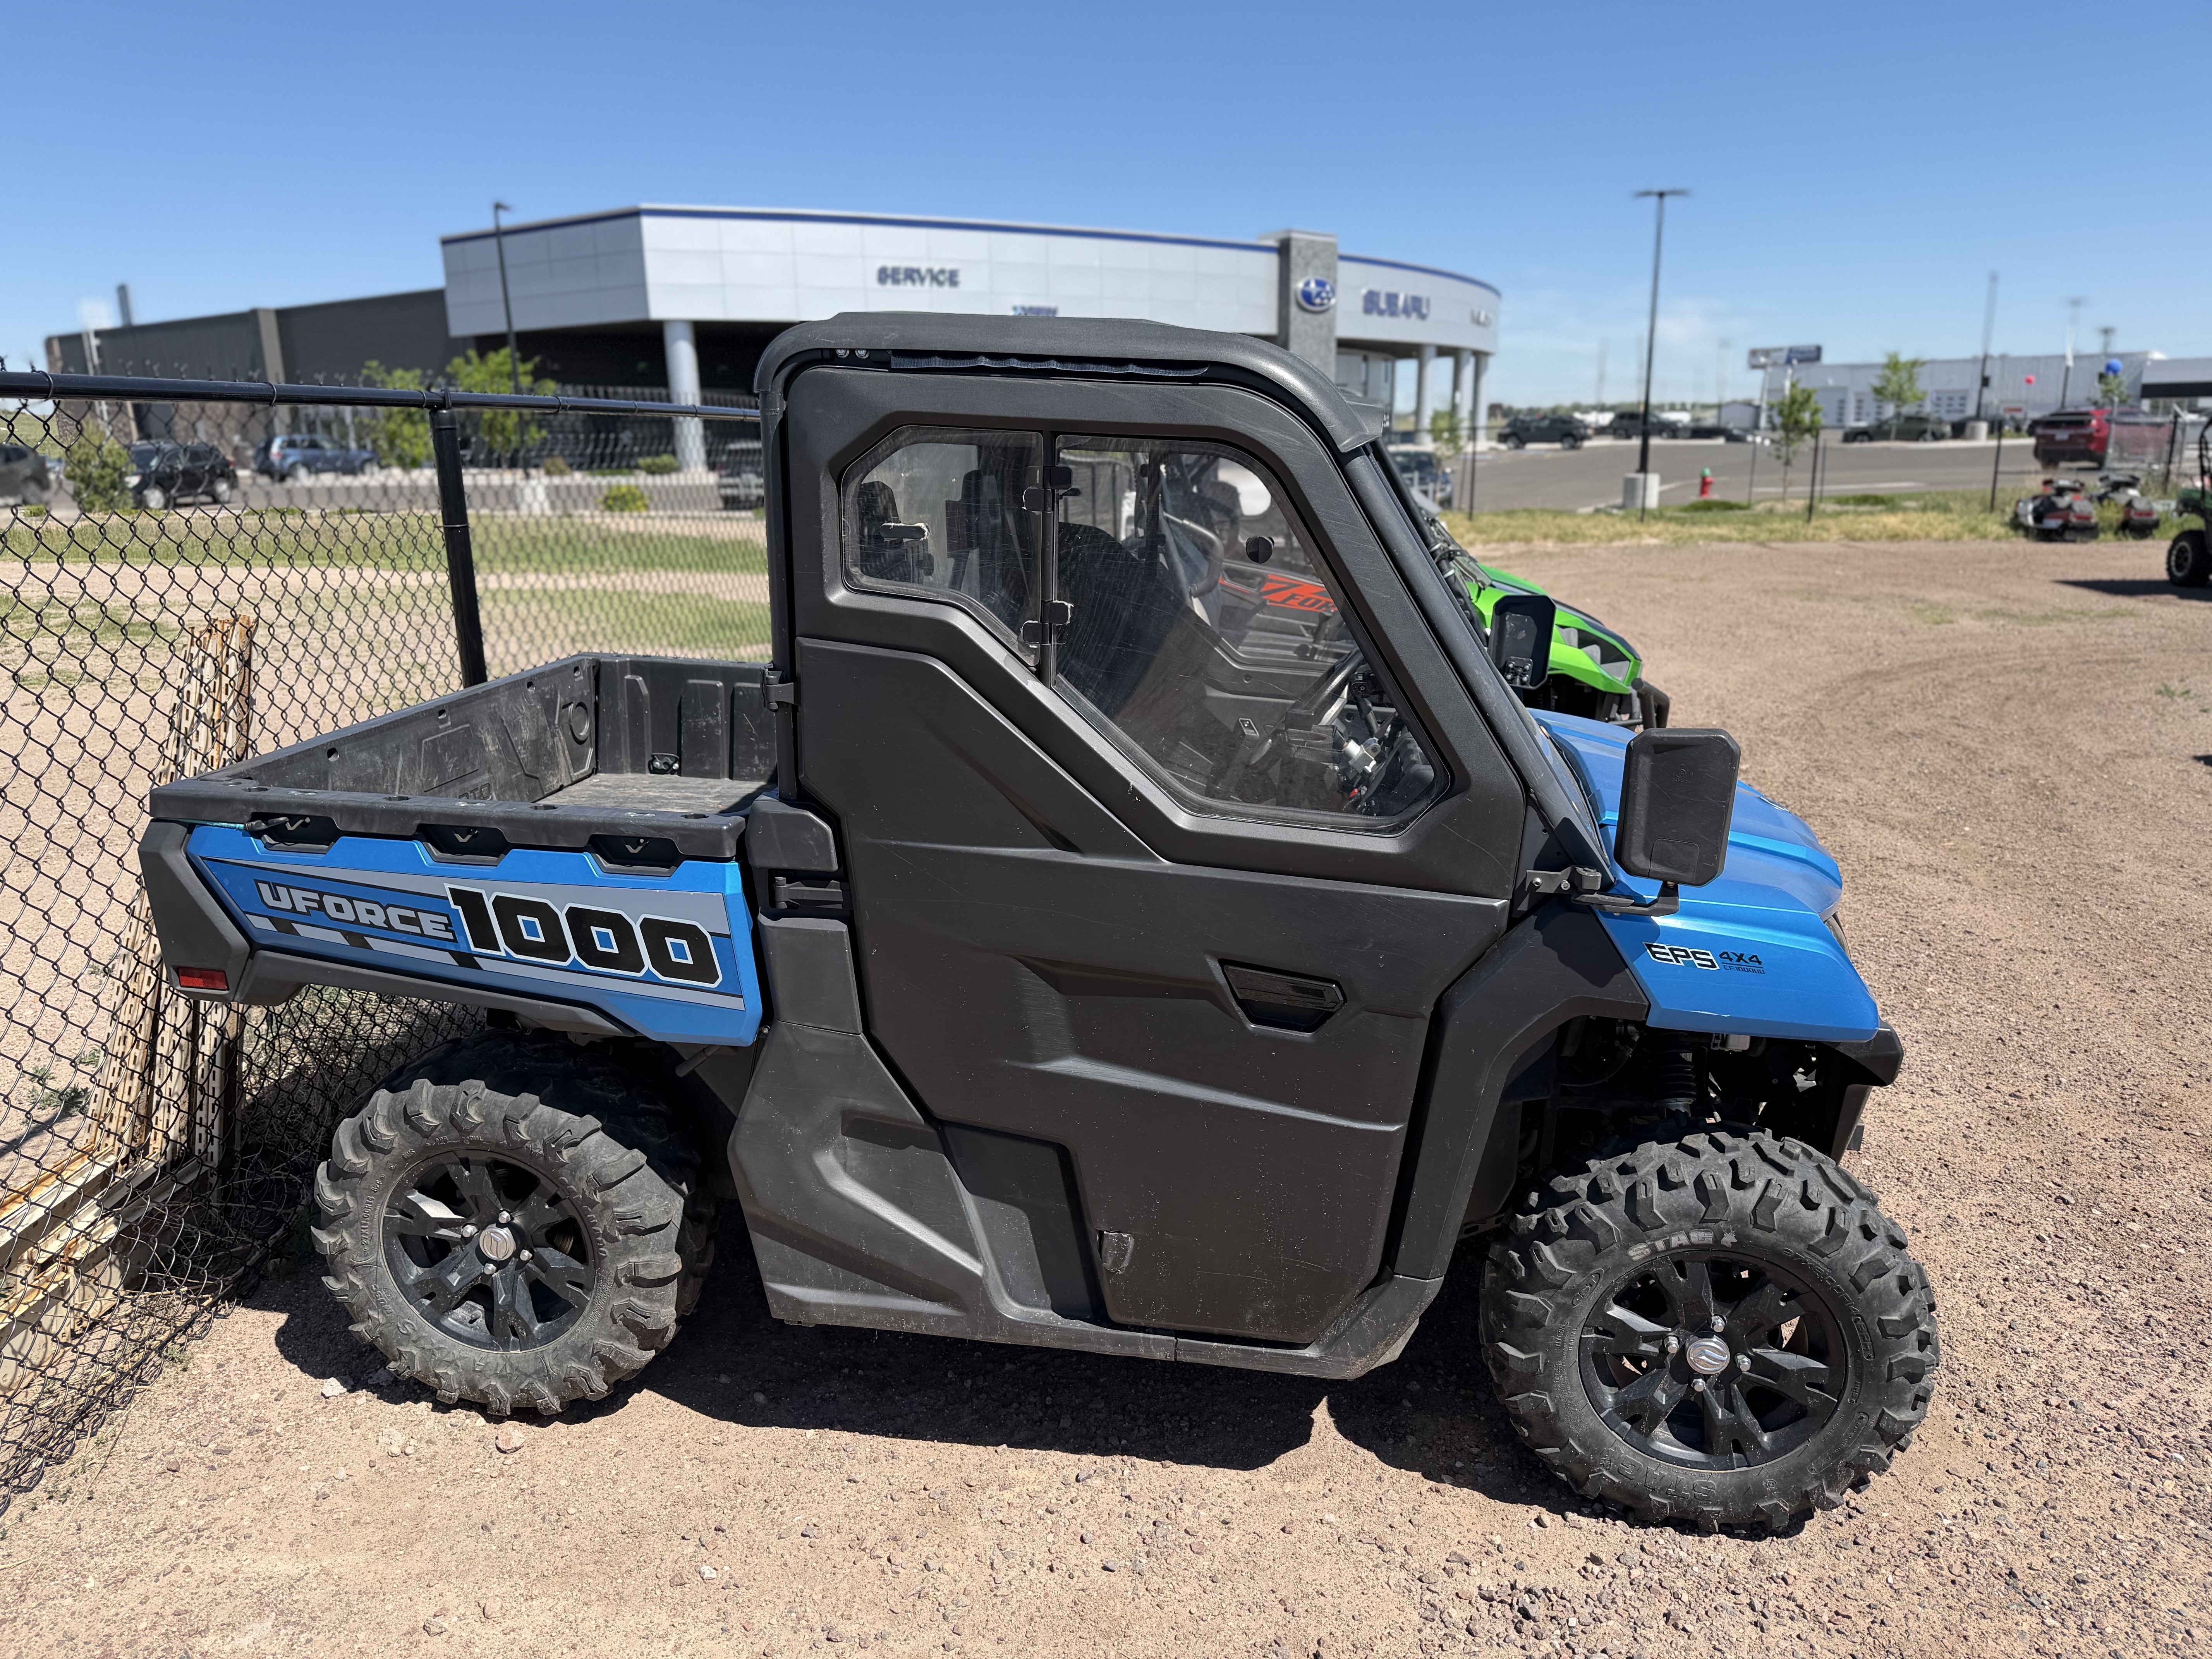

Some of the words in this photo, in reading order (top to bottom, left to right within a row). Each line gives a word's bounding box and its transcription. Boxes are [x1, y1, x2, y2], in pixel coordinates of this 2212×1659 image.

[877, 266, 960, 287] SERVICE
[256, 879, 456, 942] UFORCE
[444, 883, 723, 988] 1000
[1642, 942, 1720, 970] EPS
[1627, 1228, 1714, 1261] STAG
